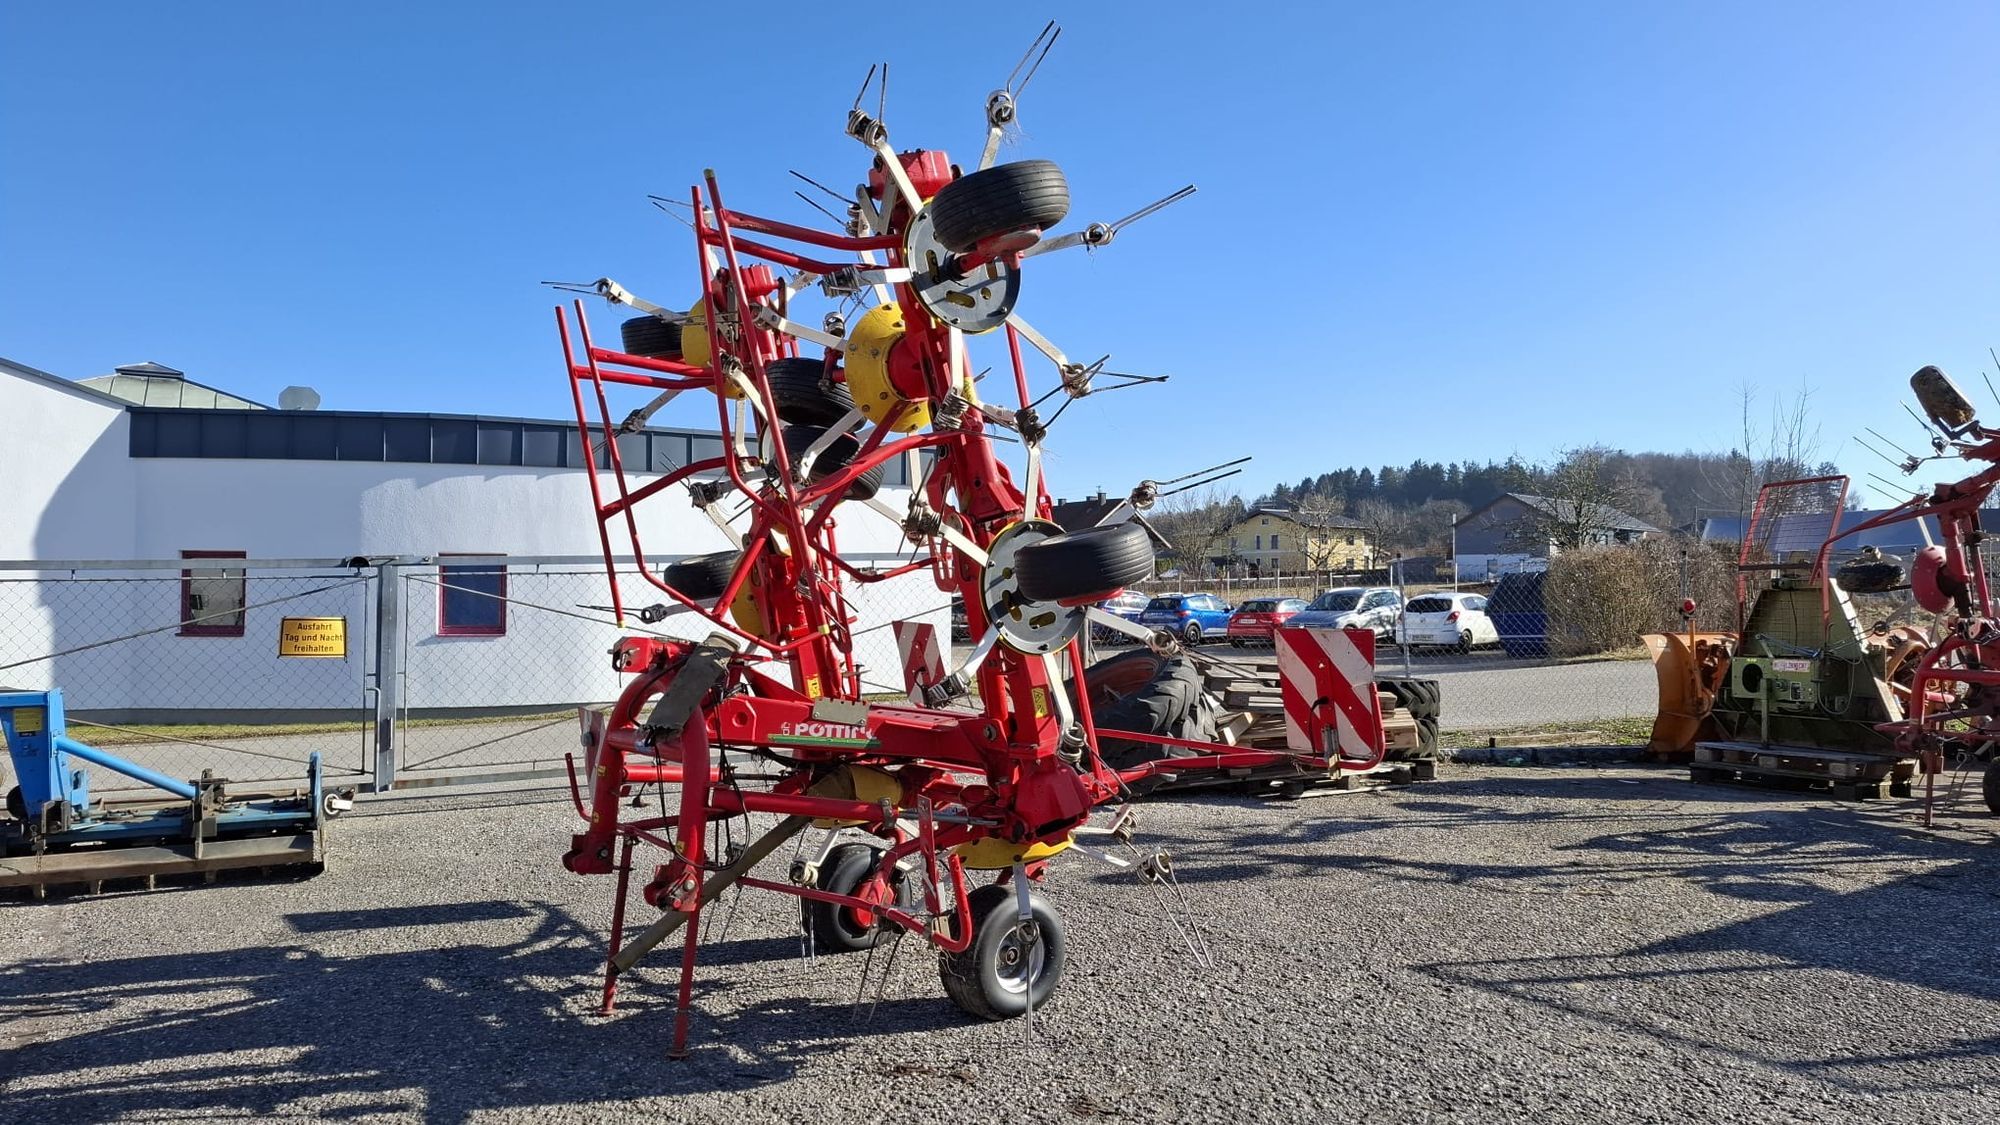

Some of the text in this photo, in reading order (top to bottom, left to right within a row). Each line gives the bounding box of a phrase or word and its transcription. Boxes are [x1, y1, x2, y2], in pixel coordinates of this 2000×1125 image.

[297, 623, 332, 631] Ausfahrt
[284, 633, 299, 642] Tag
[294, 644, 334, 652] freihalten
